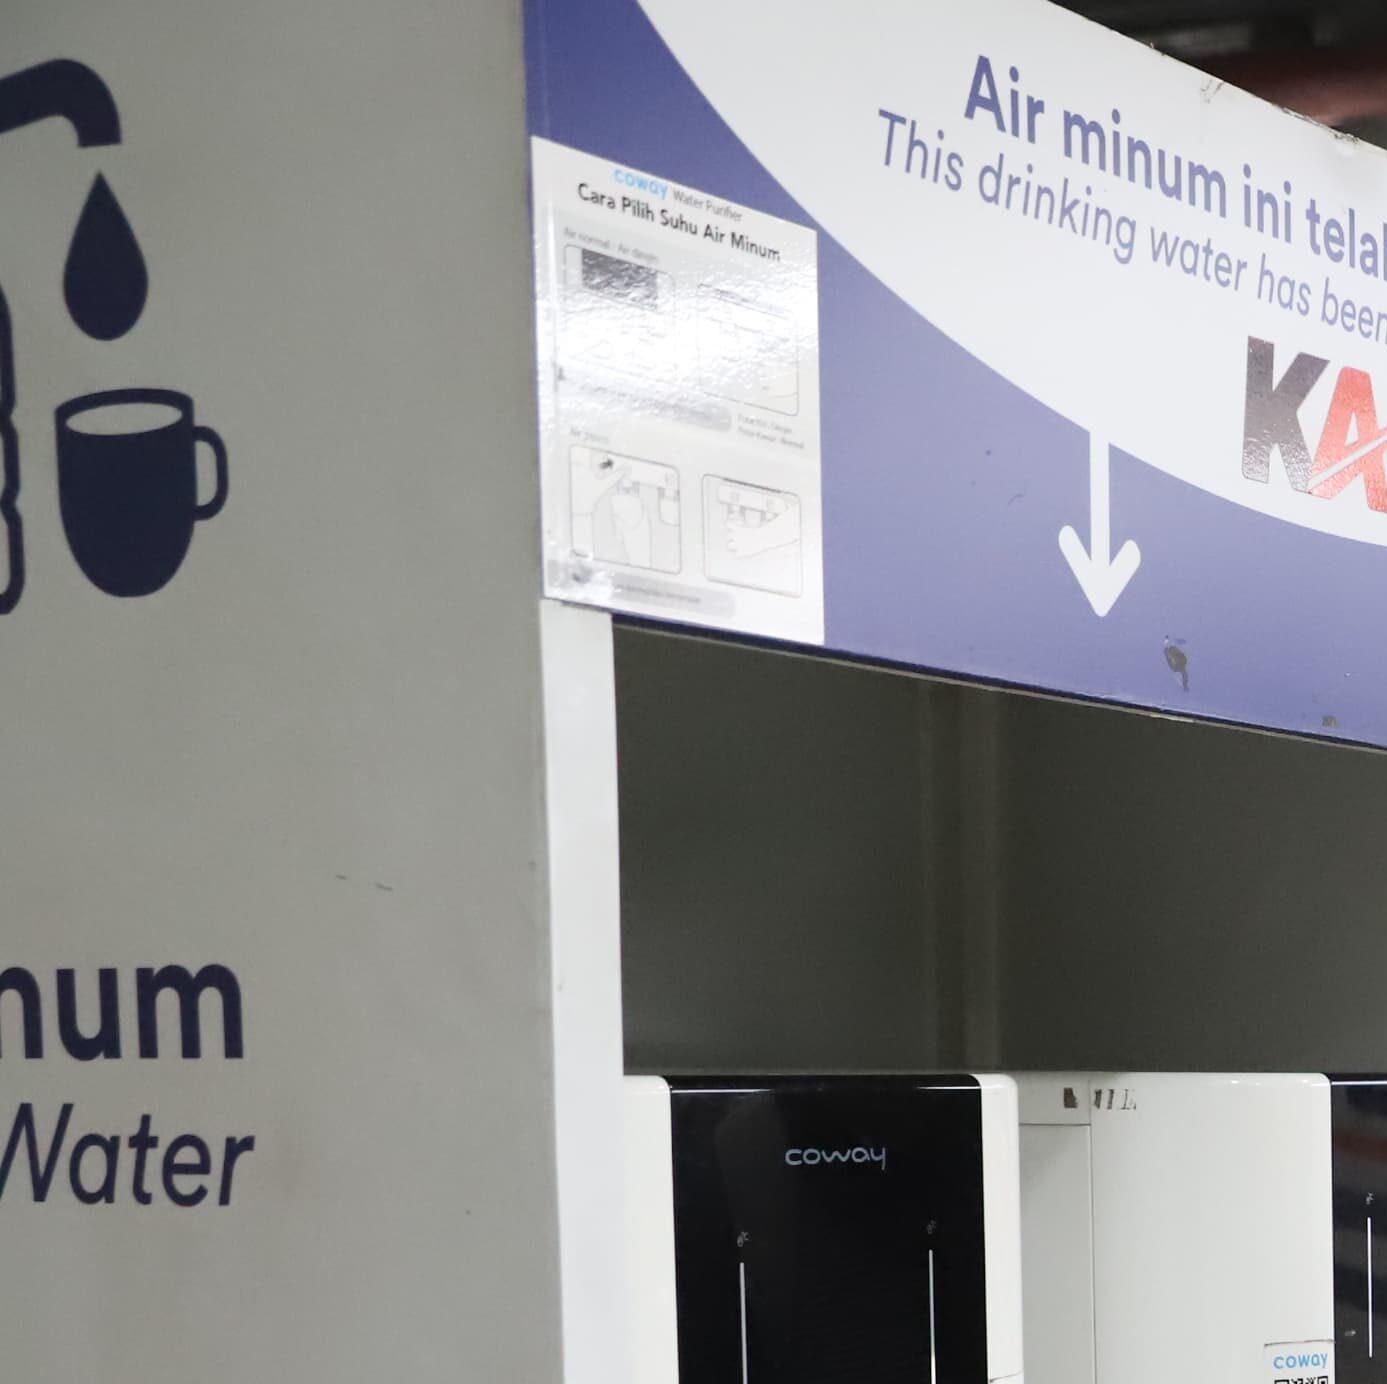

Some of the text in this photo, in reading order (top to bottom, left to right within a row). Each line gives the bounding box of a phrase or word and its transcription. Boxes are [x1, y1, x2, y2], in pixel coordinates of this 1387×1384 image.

[963, 54, 1045, 146] Air
[1062, 108, 1227, 219] minum
[1243, 163, 1293, 244] ini
[577, 182, 782, 262] Cara Pilih Suhu Air Minum
[613, 169, 744, 222] coway Water Purifier
[878, 108, 965, 192] This
[978, 153, 1137, 265] drinking
[1150, 226, 1248, 292] water
[1257, 252, 1312, 317] has
[0, 1102, 256, 1207] Water
[785, 1146, 888, 1171] coway
[1273, 1352, 1329, 1370] coway
